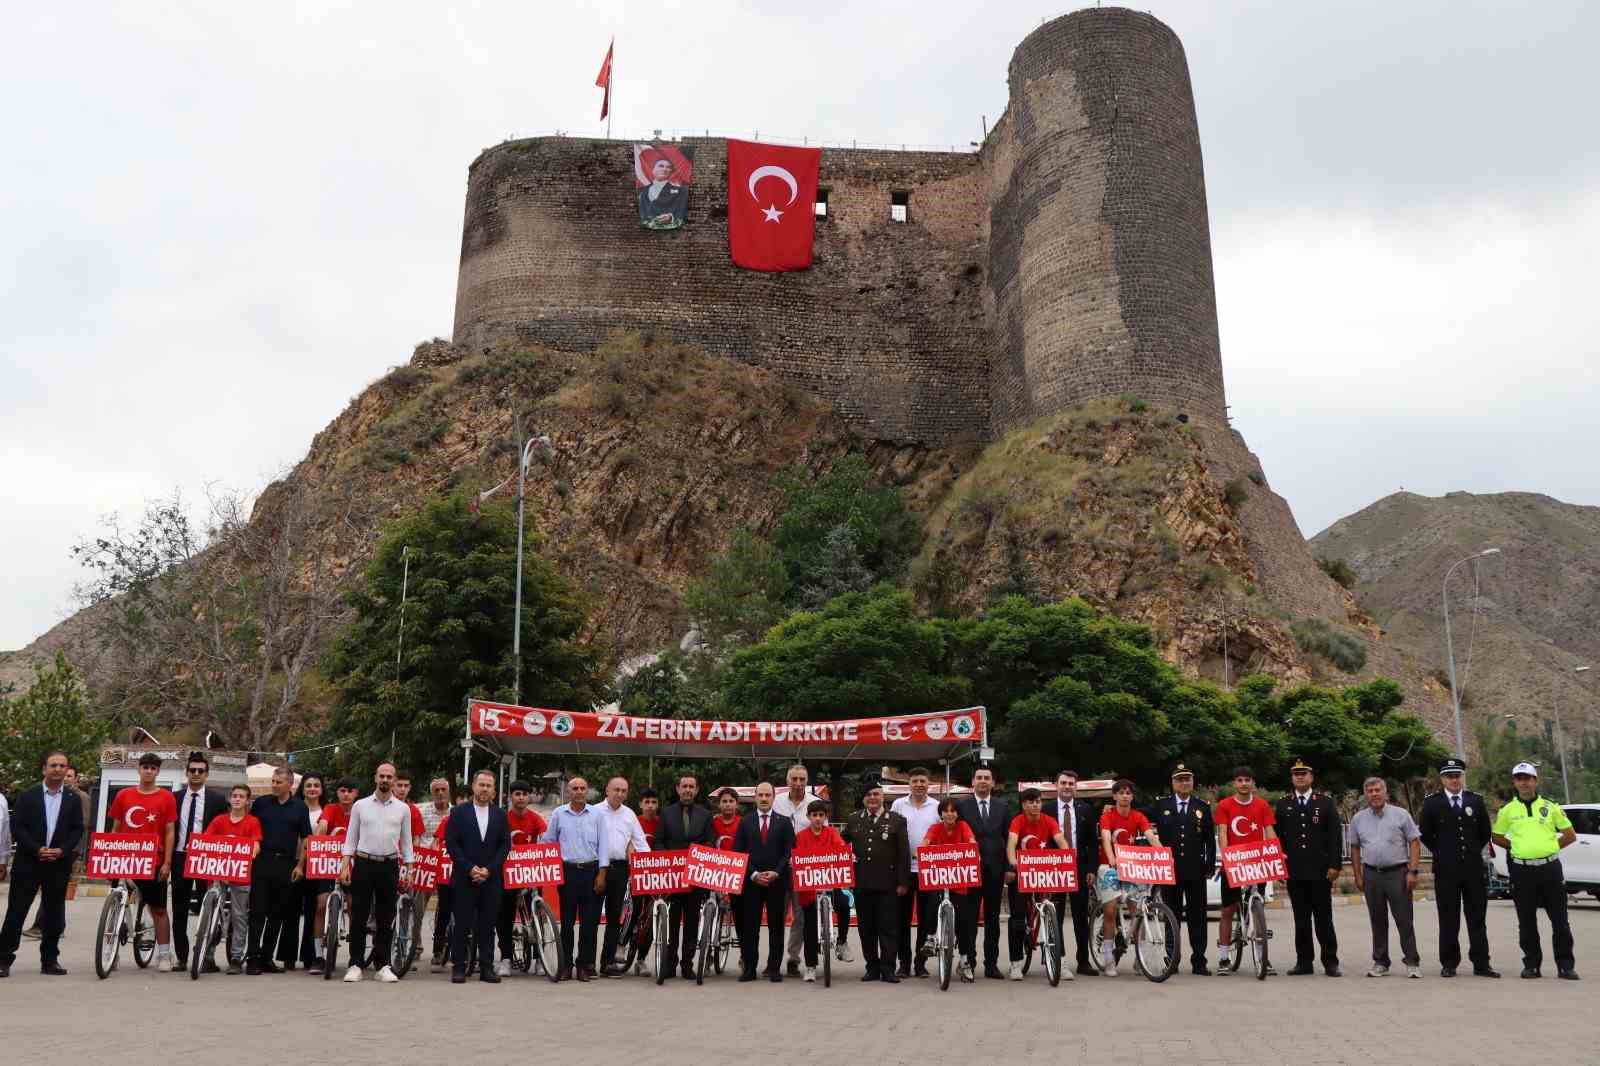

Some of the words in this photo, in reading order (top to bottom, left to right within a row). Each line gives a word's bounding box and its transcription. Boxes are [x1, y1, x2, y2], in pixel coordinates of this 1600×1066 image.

[707, 720, 749, 742] ADI
[93, 839, 141, 850] Mücadelenin
[141, 840, 154, 851] Adı
[191, 838, 232, 854] Direnişin
[234, 842, 250, 854] Adı
[545, 847, 558, 858] Adı
[964, 849, 976, 859] Adı
[1262, 844, 1279, 856] Adı
[91, 852, 153, 874] TÜRKİYE
[189, 853, 249, 877] TÜRKİYE
[309, 853, 344, 875] TÜRK
[731, 857, 744, 867] Adı
[795, 853, 837, 865] Demokrasinin
[839, 852, 850, 861] Adı
[1062, 854, 1073, 864] Adı
[1153, 851, 1170, 861] Adı
[506, 861, 561, 884] TÜRKİYE
[687, 863, 742, 890] TÜRKİYE
[795, 864, 851, 887] TÜRKİYE
[921, 863, 978, 886] TÜRKİYE
[1020, 867, 1076, 889] TÜRKİYE
[1119, 860, 1173, 881] TÜRKİYE
[1228, 858, 1285, 884] TÜRKİYE
